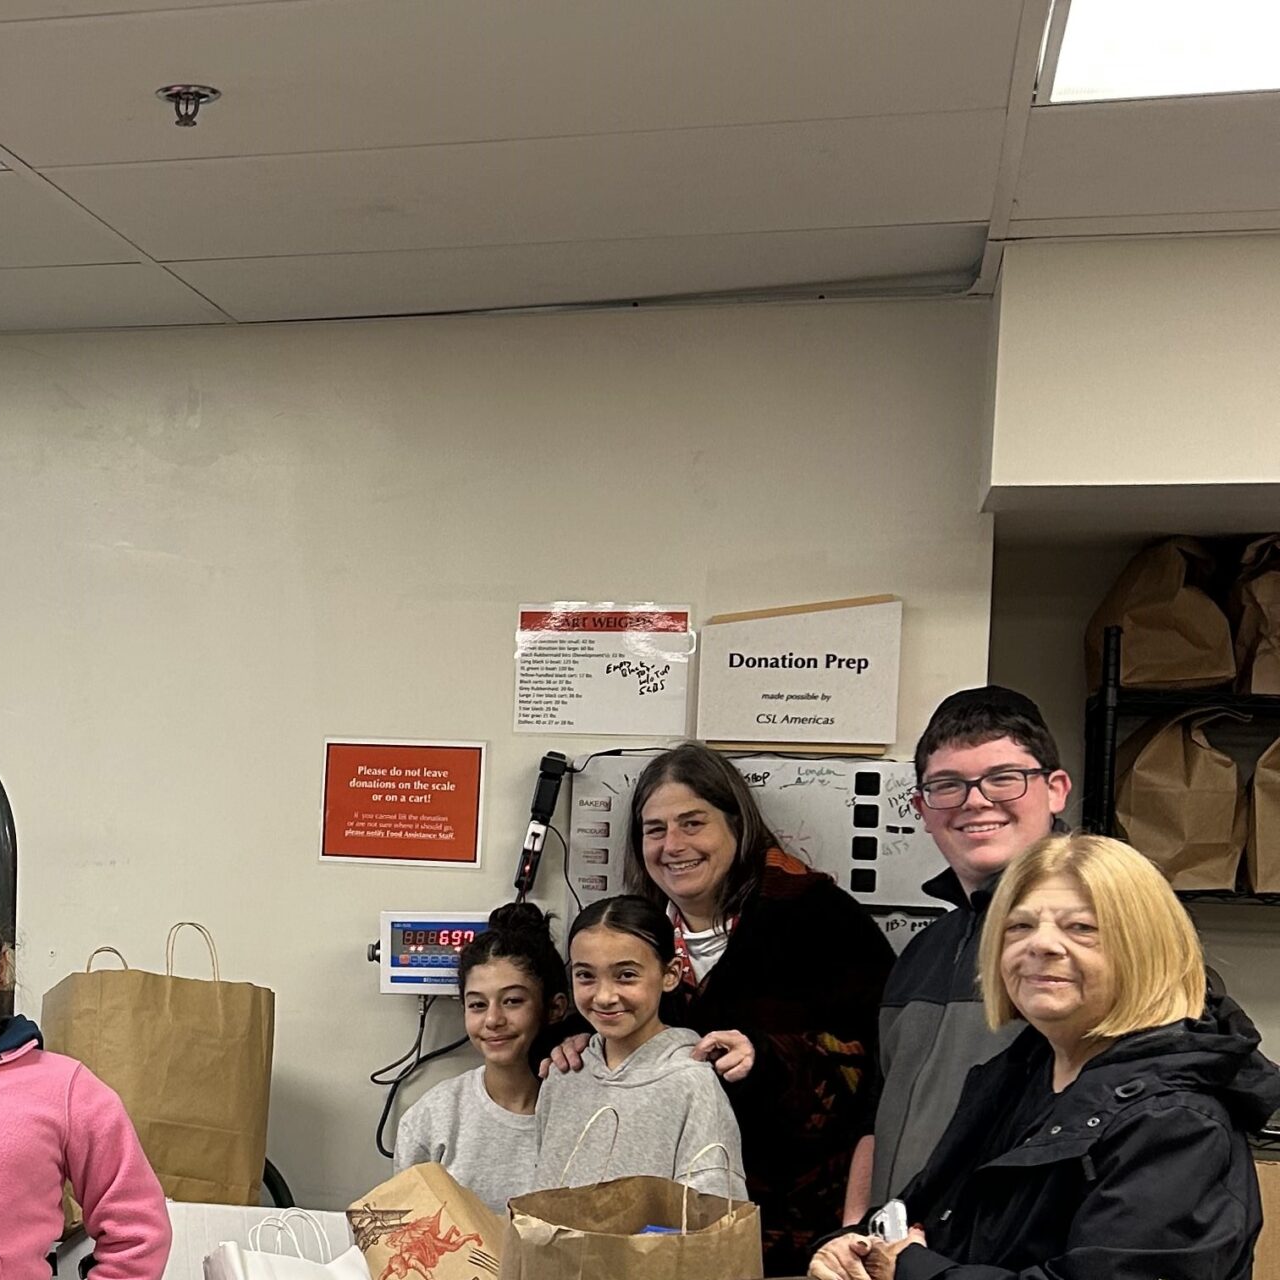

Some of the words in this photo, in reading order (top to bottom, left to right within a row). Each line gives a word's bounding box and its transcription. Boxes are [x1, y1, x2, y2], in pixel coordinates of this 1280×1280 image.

[592, 616, 654, 628] WEIG
[728, 652, 819, 669] Donation
[825, 653, 869, 675] Prep
[761, 692, 785, 700] made
[785, 692, 820, 702] possible
[820, 692, 832, 703] by
[756, 713, 778, 724] CSL
[780, 714, 836, 725] Americas
[357, 766, 388, 776] Please
[390, 766, 403, 776] do
[404, 768, 421, 777] not
[423, 767, 449, 778] leave
[349, 777, 396, 789] donations
[398, 782, 411, 790] on
[413, 780, 429, 790] the
[431, 781, 456, 791] scale
[372, 793, 383, 801] or
[385, 794, 398, 802] on
[408, 793, 432, 803] cart!
